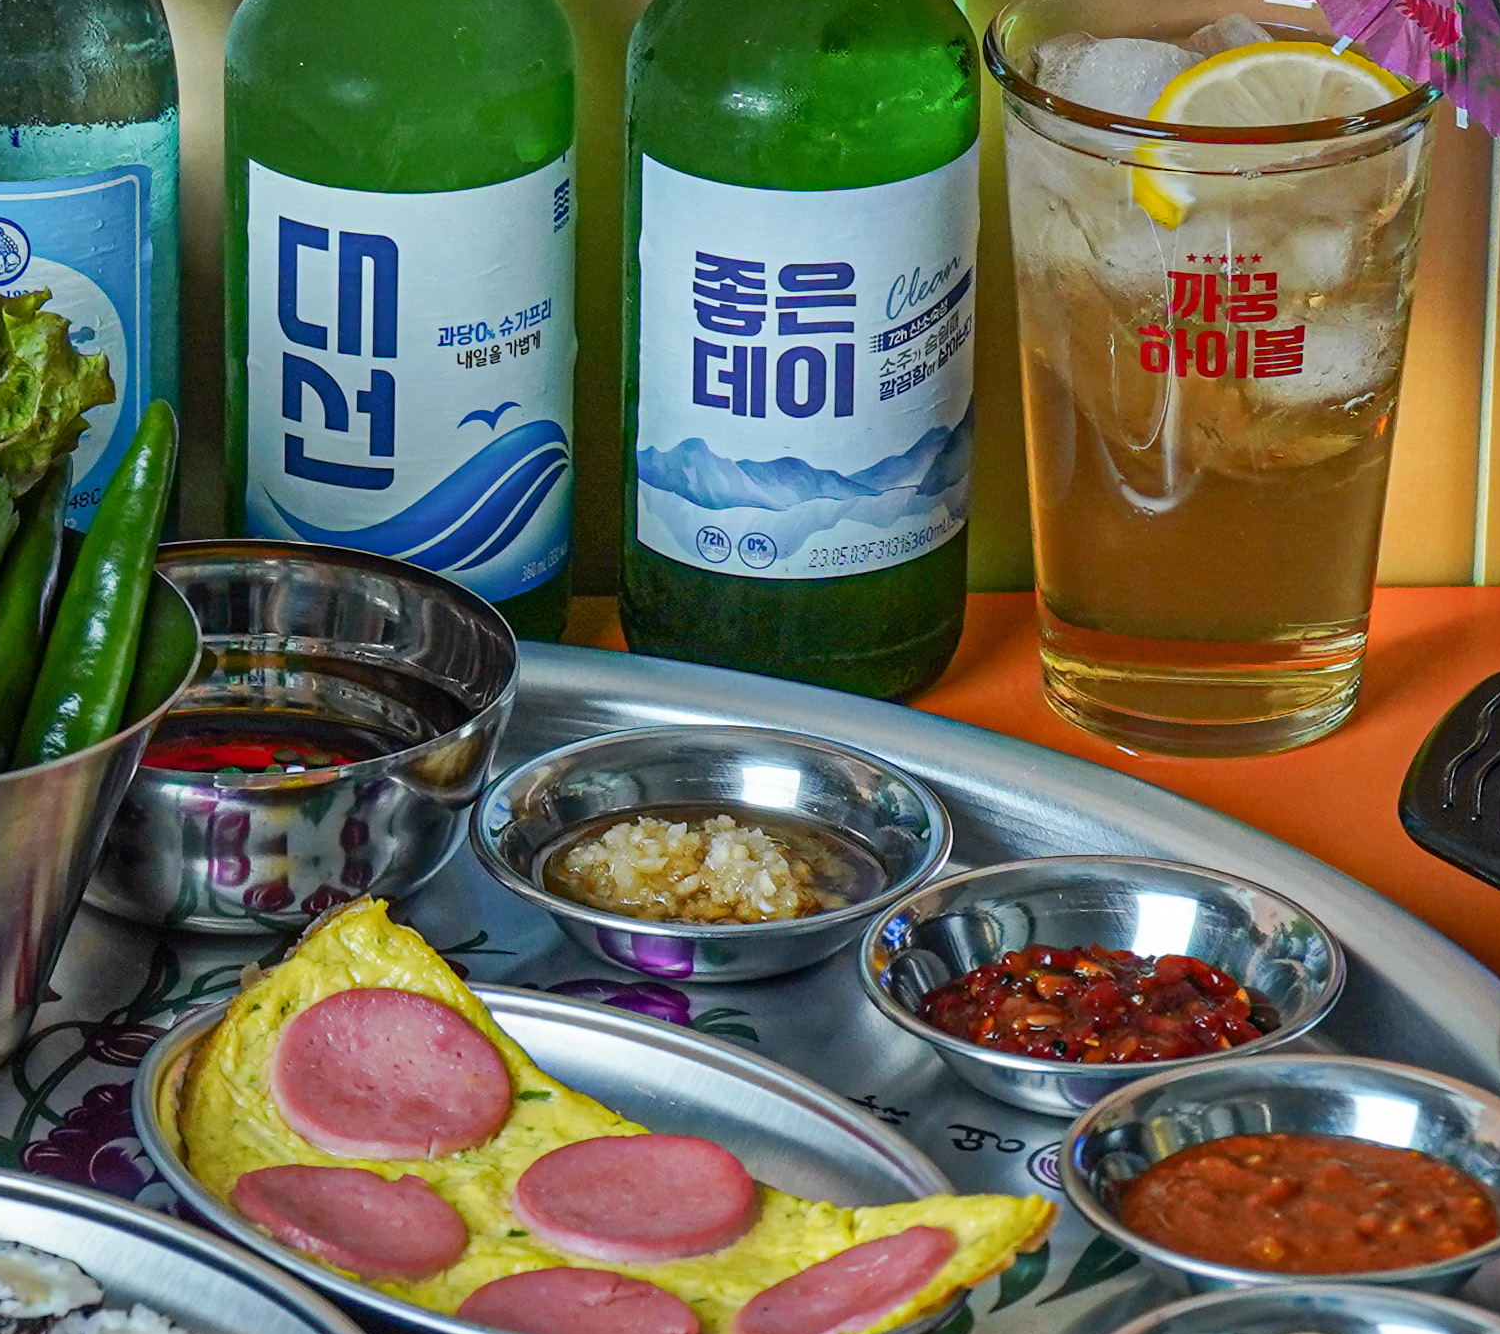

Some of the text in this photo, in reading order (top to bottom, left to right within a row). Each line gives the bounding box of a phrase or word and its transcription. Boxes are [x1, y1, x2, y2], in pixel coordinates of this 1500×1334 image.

[693, 251, 856, 336] 좋은
[886, 256, 961, 320] Clean
[1168, 271, 1278, 322] 까꿍
[500, 298, 552, 337] 슈가프리
[457, 329, 541, 369] 내일을 가볍게
[888, 331, 909, 347] 72h
[1138, 324, 1305, 379] 하이볼
[693, 336, 855, 418] 데이
[879, 349, 921, 378] 소주가
[703, 530, 724, 547] 72h
[748, 538, 767, 551] 0%
